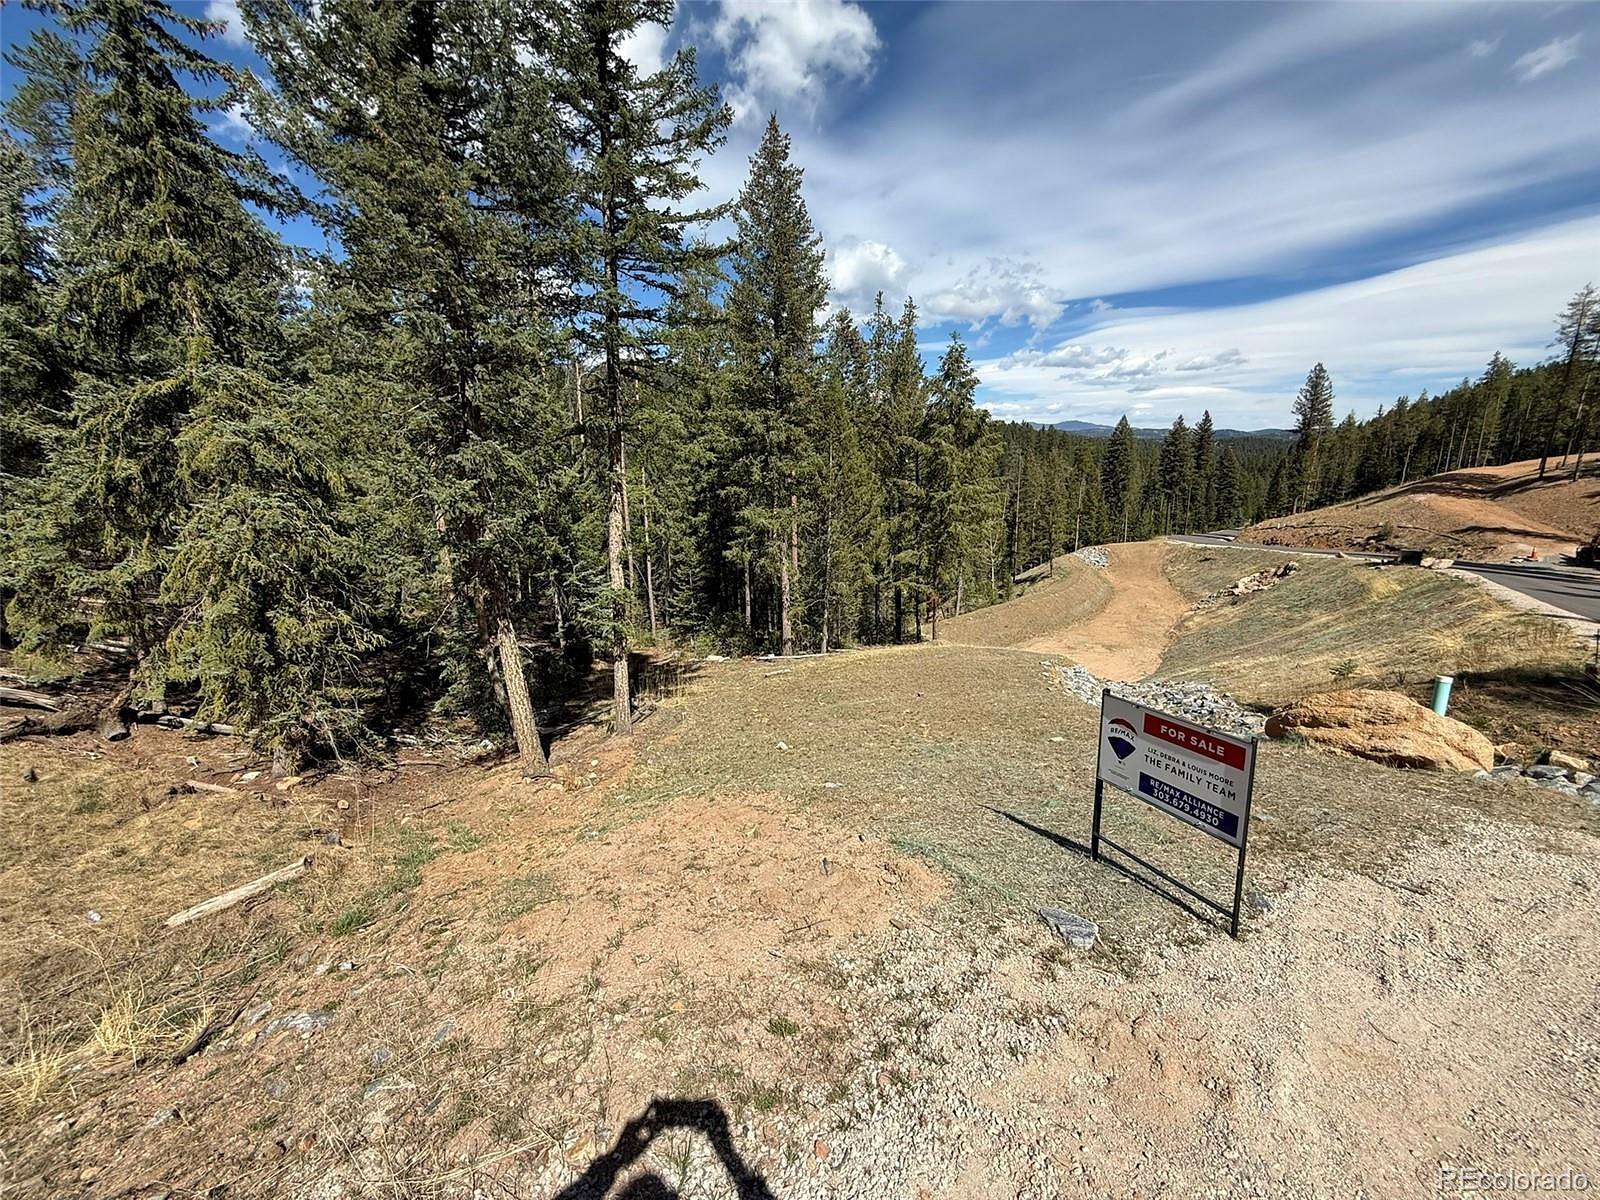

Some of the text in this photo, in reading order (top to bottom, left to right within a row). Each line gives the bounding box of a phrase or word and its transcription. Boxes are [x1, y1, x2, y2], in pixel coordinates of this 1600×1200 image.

[1110, 727, 1135, 742] RE/MAX
[1160, 725, 1225, 756] FOR SALE
[1144, 754, 1236, 801] THE FAMILY TEAM
[1160, 753, 1180, 764] DEBRA
[1188, 762, 1207, 776] LOUIS
[1208, 770, 1234, 787] MOORE
[1150, 779, 1224, 820] RE/MAX ALLIANCE
[1152, 788, 1219, 826] 303.679.4930
